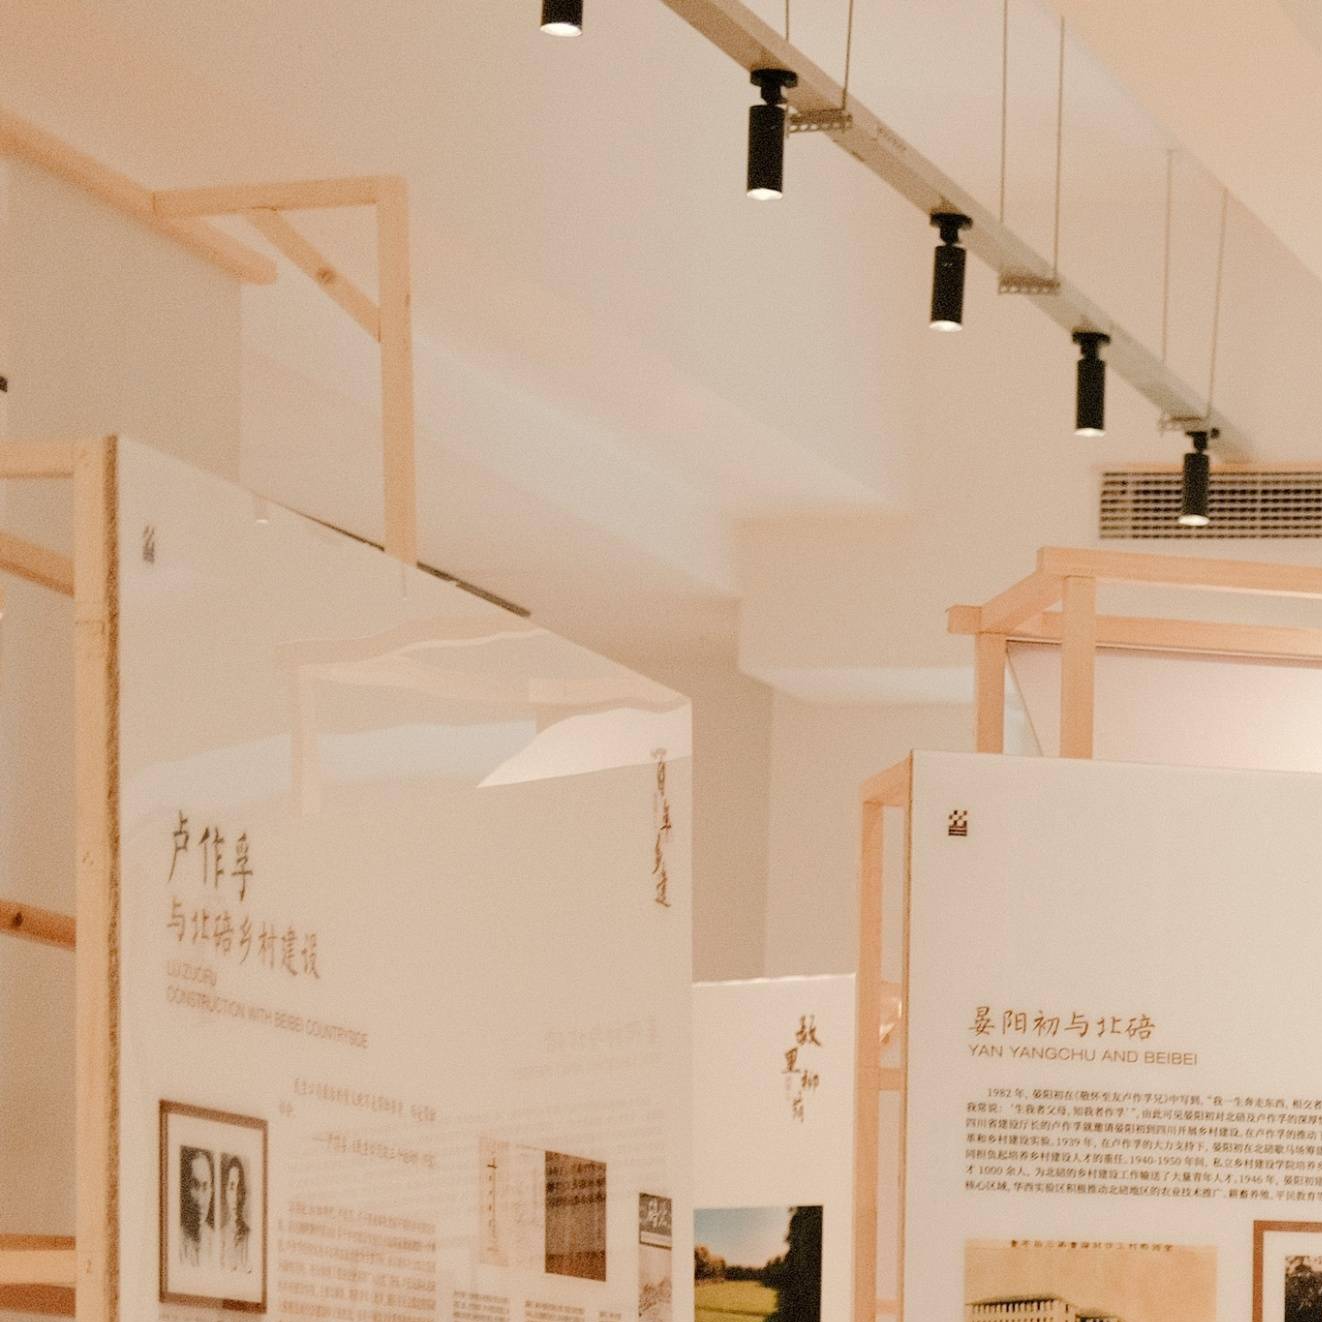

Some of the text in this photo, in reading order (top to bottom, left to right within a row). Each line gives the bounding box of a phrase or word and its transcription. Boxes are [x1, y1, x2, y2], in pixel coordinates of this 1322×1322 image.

[167, 809, 253, 902] 卢作孚
[167, 896, 321, 979] 与北碚乡村建设
[968, 1005, 1156, 1041] 晏阳初与北碚
[968, 1044, 1198, 1066] YAN YANGCHU AND BEIBEI
